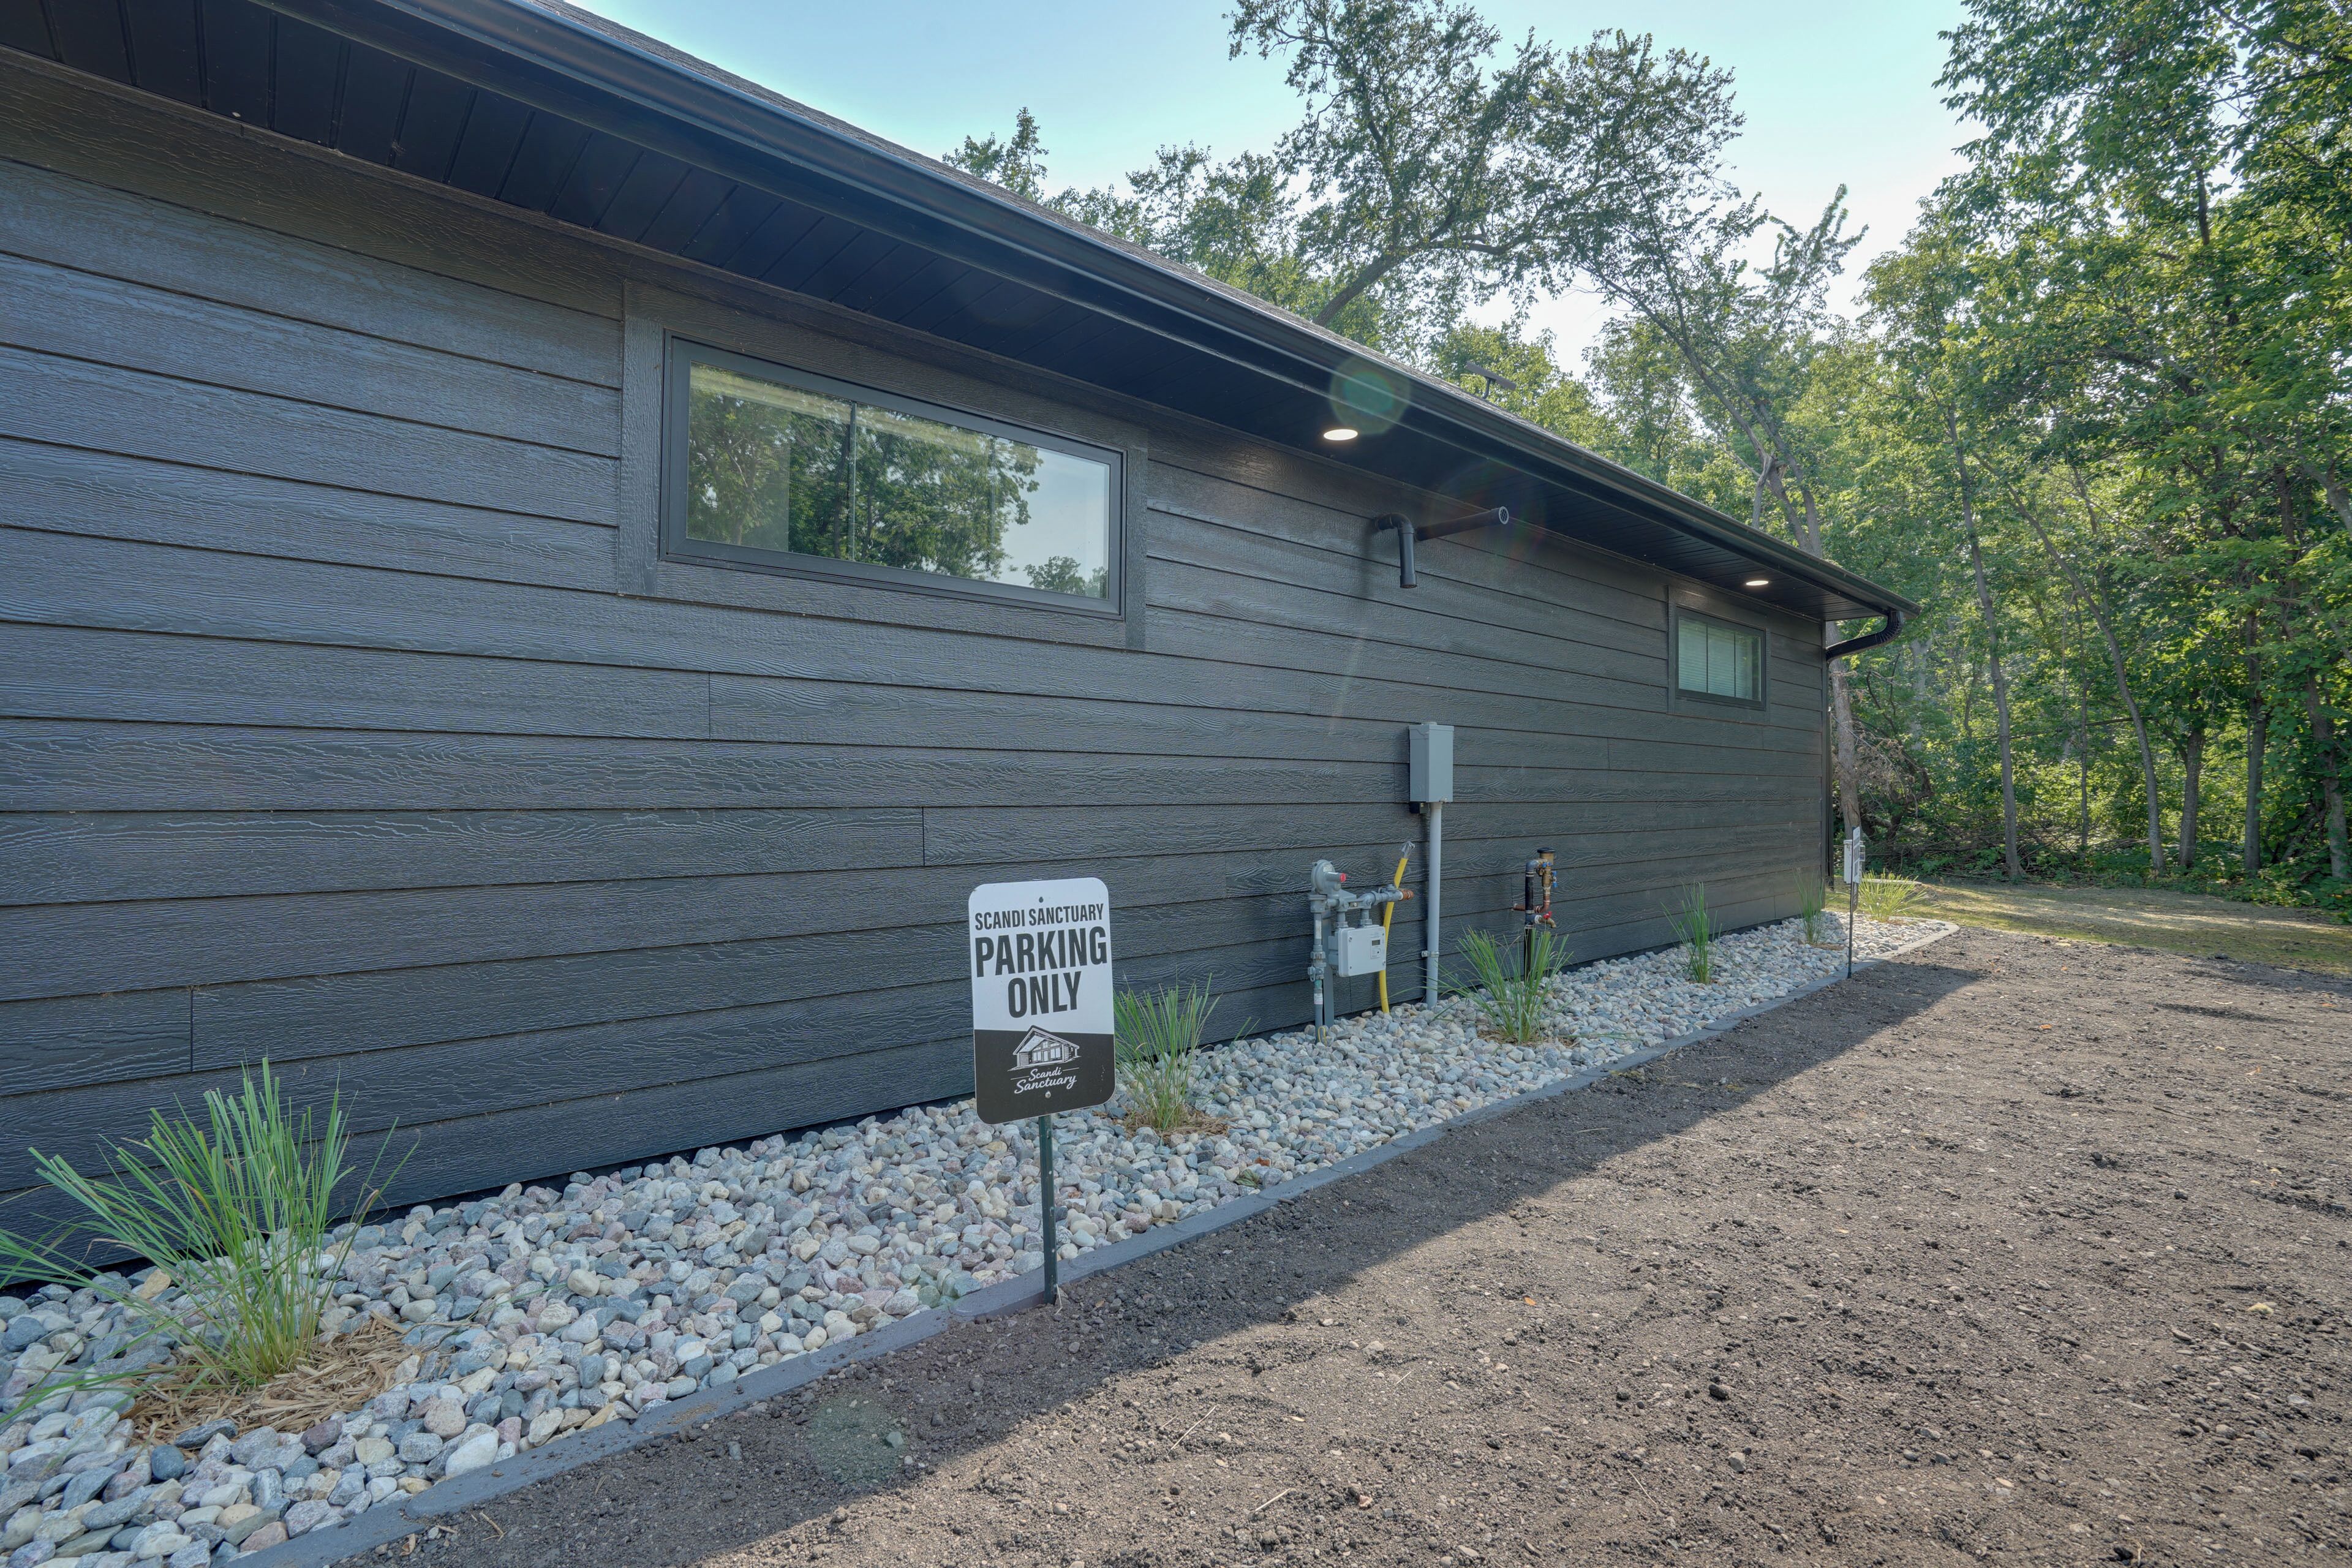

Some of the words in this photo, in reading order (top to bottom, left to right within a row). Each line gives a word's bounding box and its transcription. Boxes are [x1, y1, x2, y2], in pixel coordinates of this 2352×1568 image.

[975, 910, 1025, 930] SCANDI
[1029, 903, 1104, 926] SANCTUARY
[975, 926, 1107, 978] PARKING
[1008, 971, 1082, 1018] ONLY
[1014, 1074, 1077, 1094] Sanctuary
[1028, 1066, 1062, 1082] Scandi
